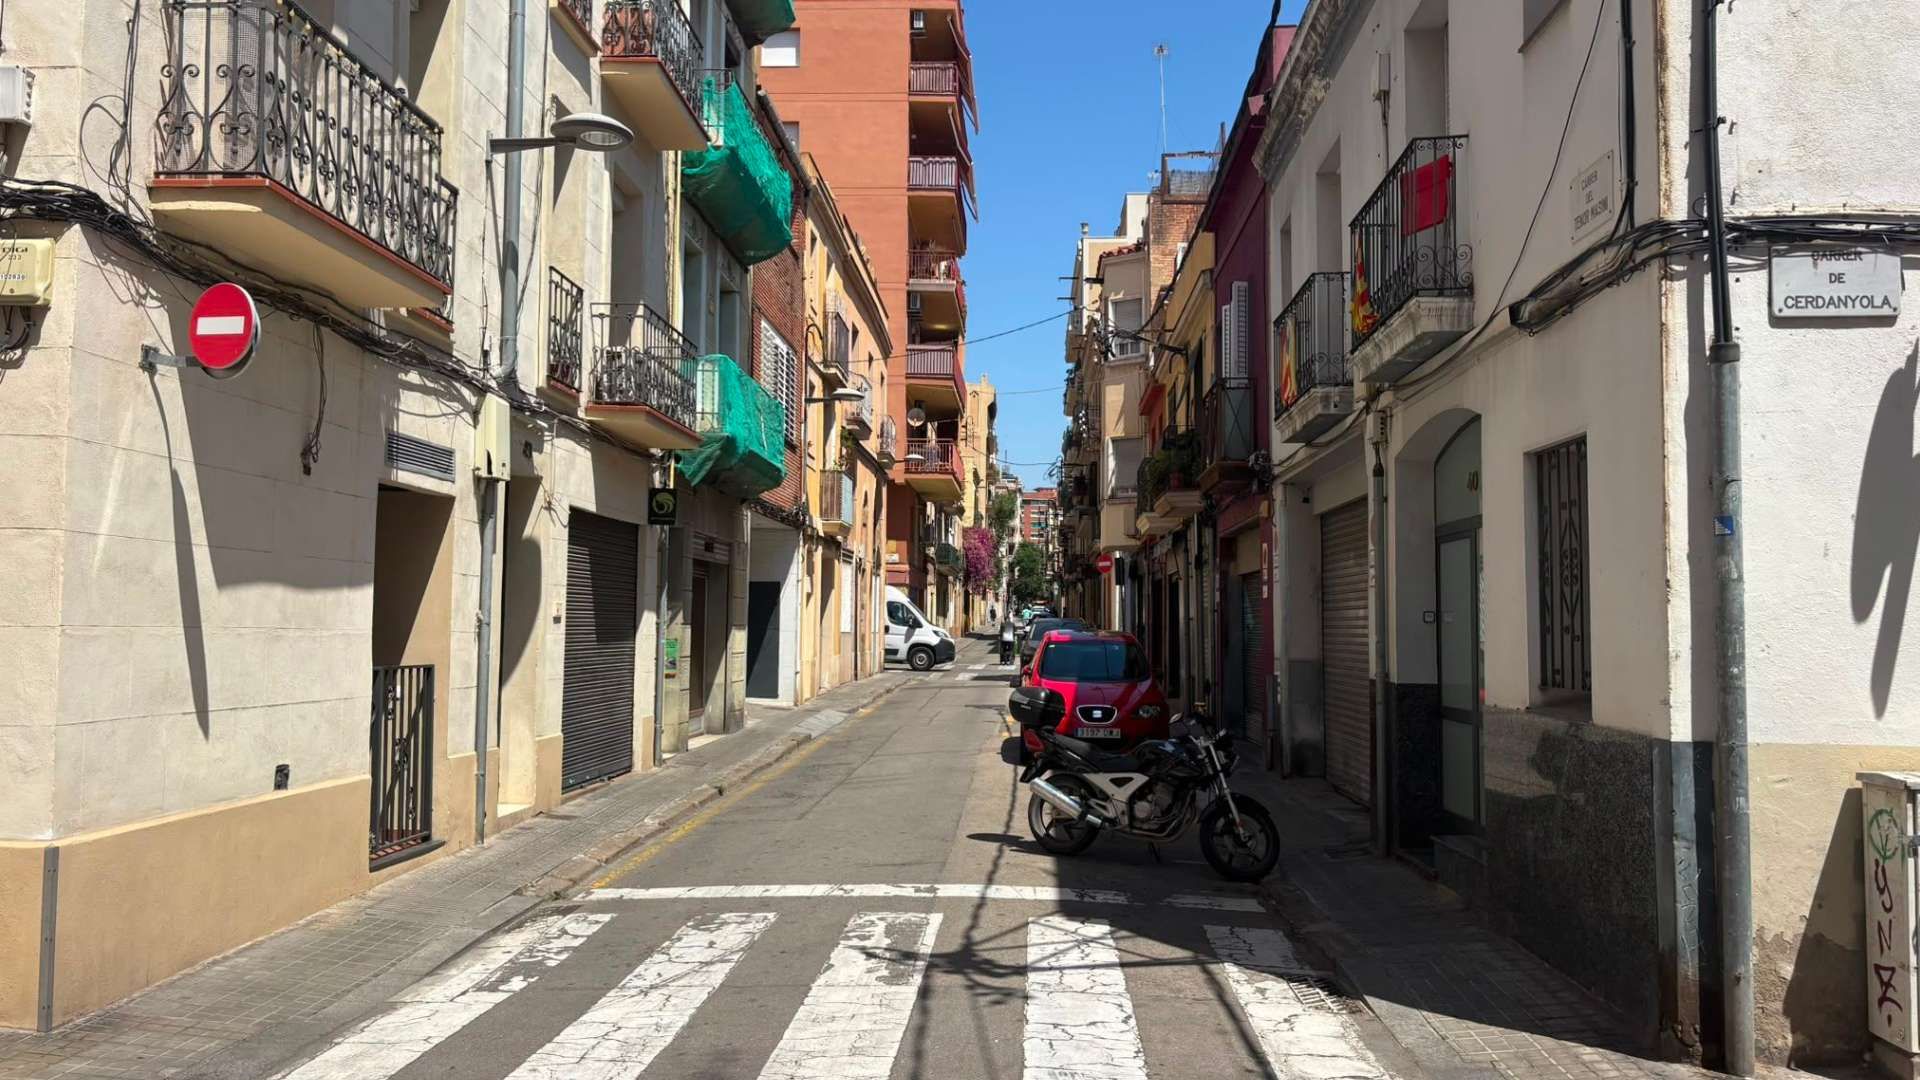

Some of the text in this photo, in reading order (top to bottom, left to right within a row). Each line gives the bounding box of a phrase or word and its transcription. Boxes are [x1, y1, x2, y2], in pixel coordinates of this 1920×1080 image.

[1811, 250, 1863, 261] CARRER
[1828, 272, 1846, 284] DE
[1783, 294, 1893, 310] CERDANYOLA
